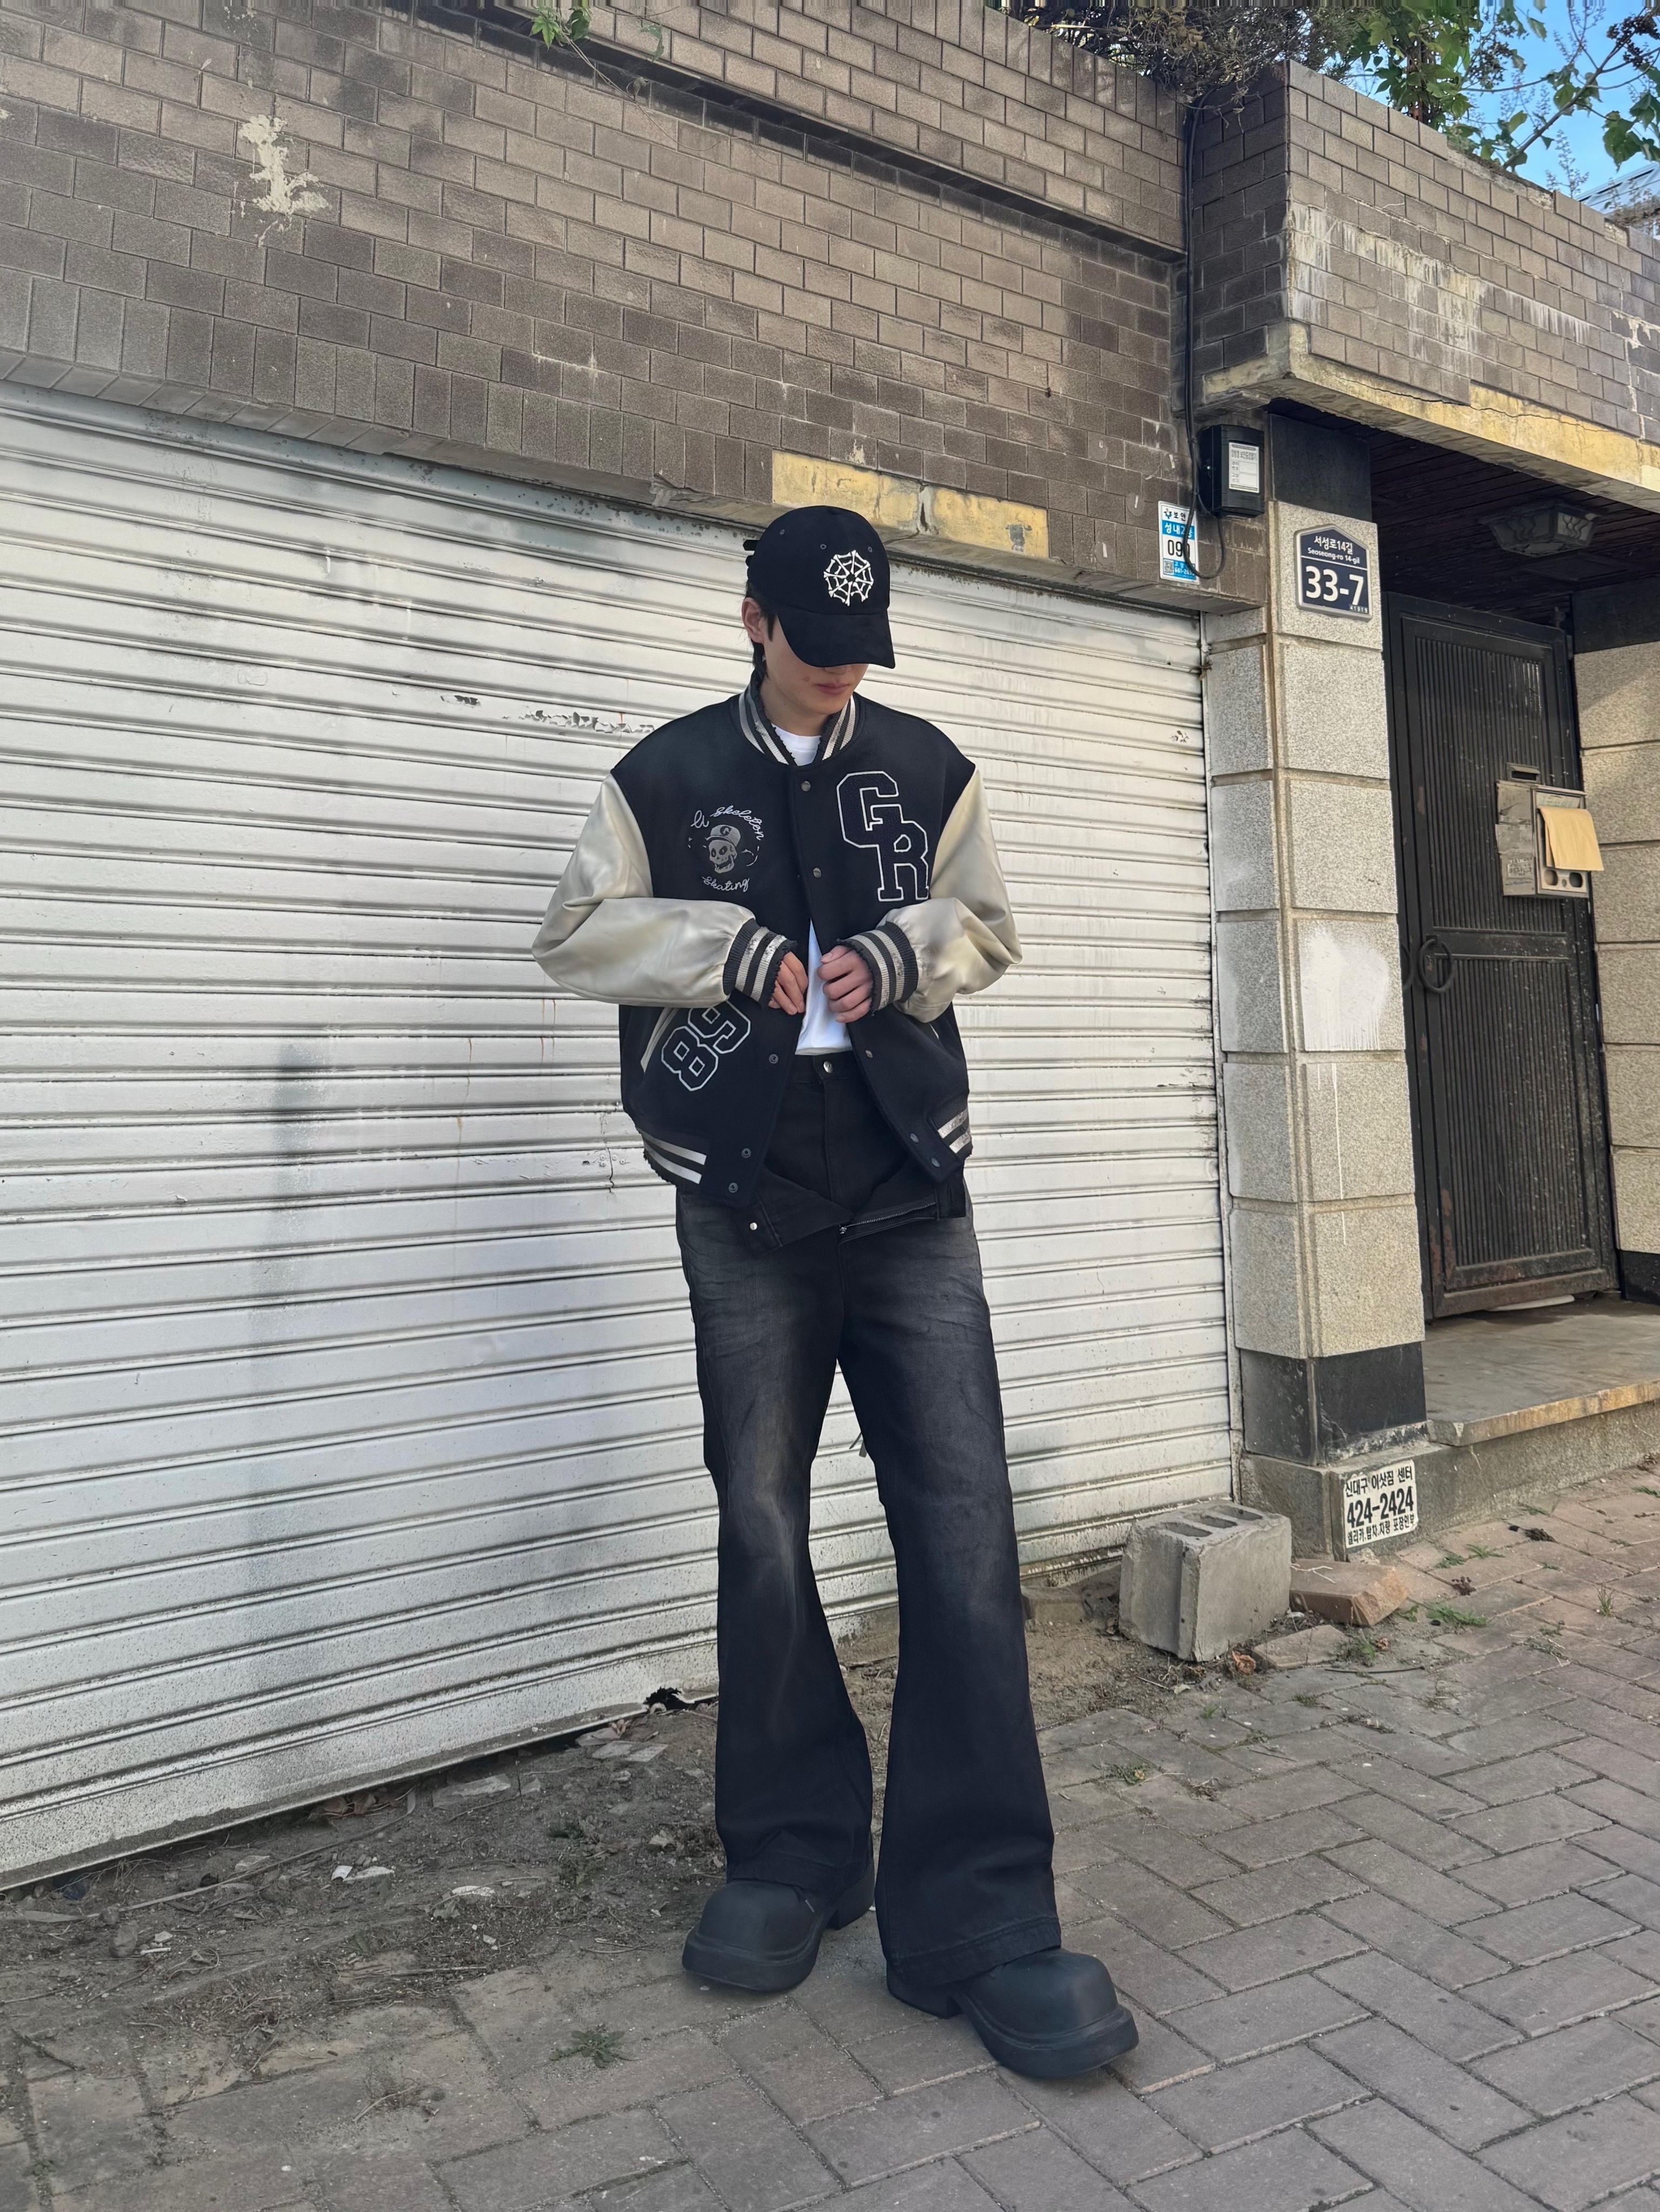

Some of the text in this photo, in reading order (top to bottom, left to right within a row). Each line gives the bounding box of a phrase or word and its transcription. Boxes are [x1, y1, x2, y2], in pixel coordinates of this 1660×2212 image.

[1307, 547, 1360, 564] Seoseong-ro 14-gil
[1314, 536, 1353, 555] 서성로14길
[1306, 565, 1363, 605] 33-7
[661, 1000, 751, 1091] 89
[1345, 1466, 1413, 1498] 신대구 이삿짐 센터
[1347, 1486, 1414, 1528] 424-2424
